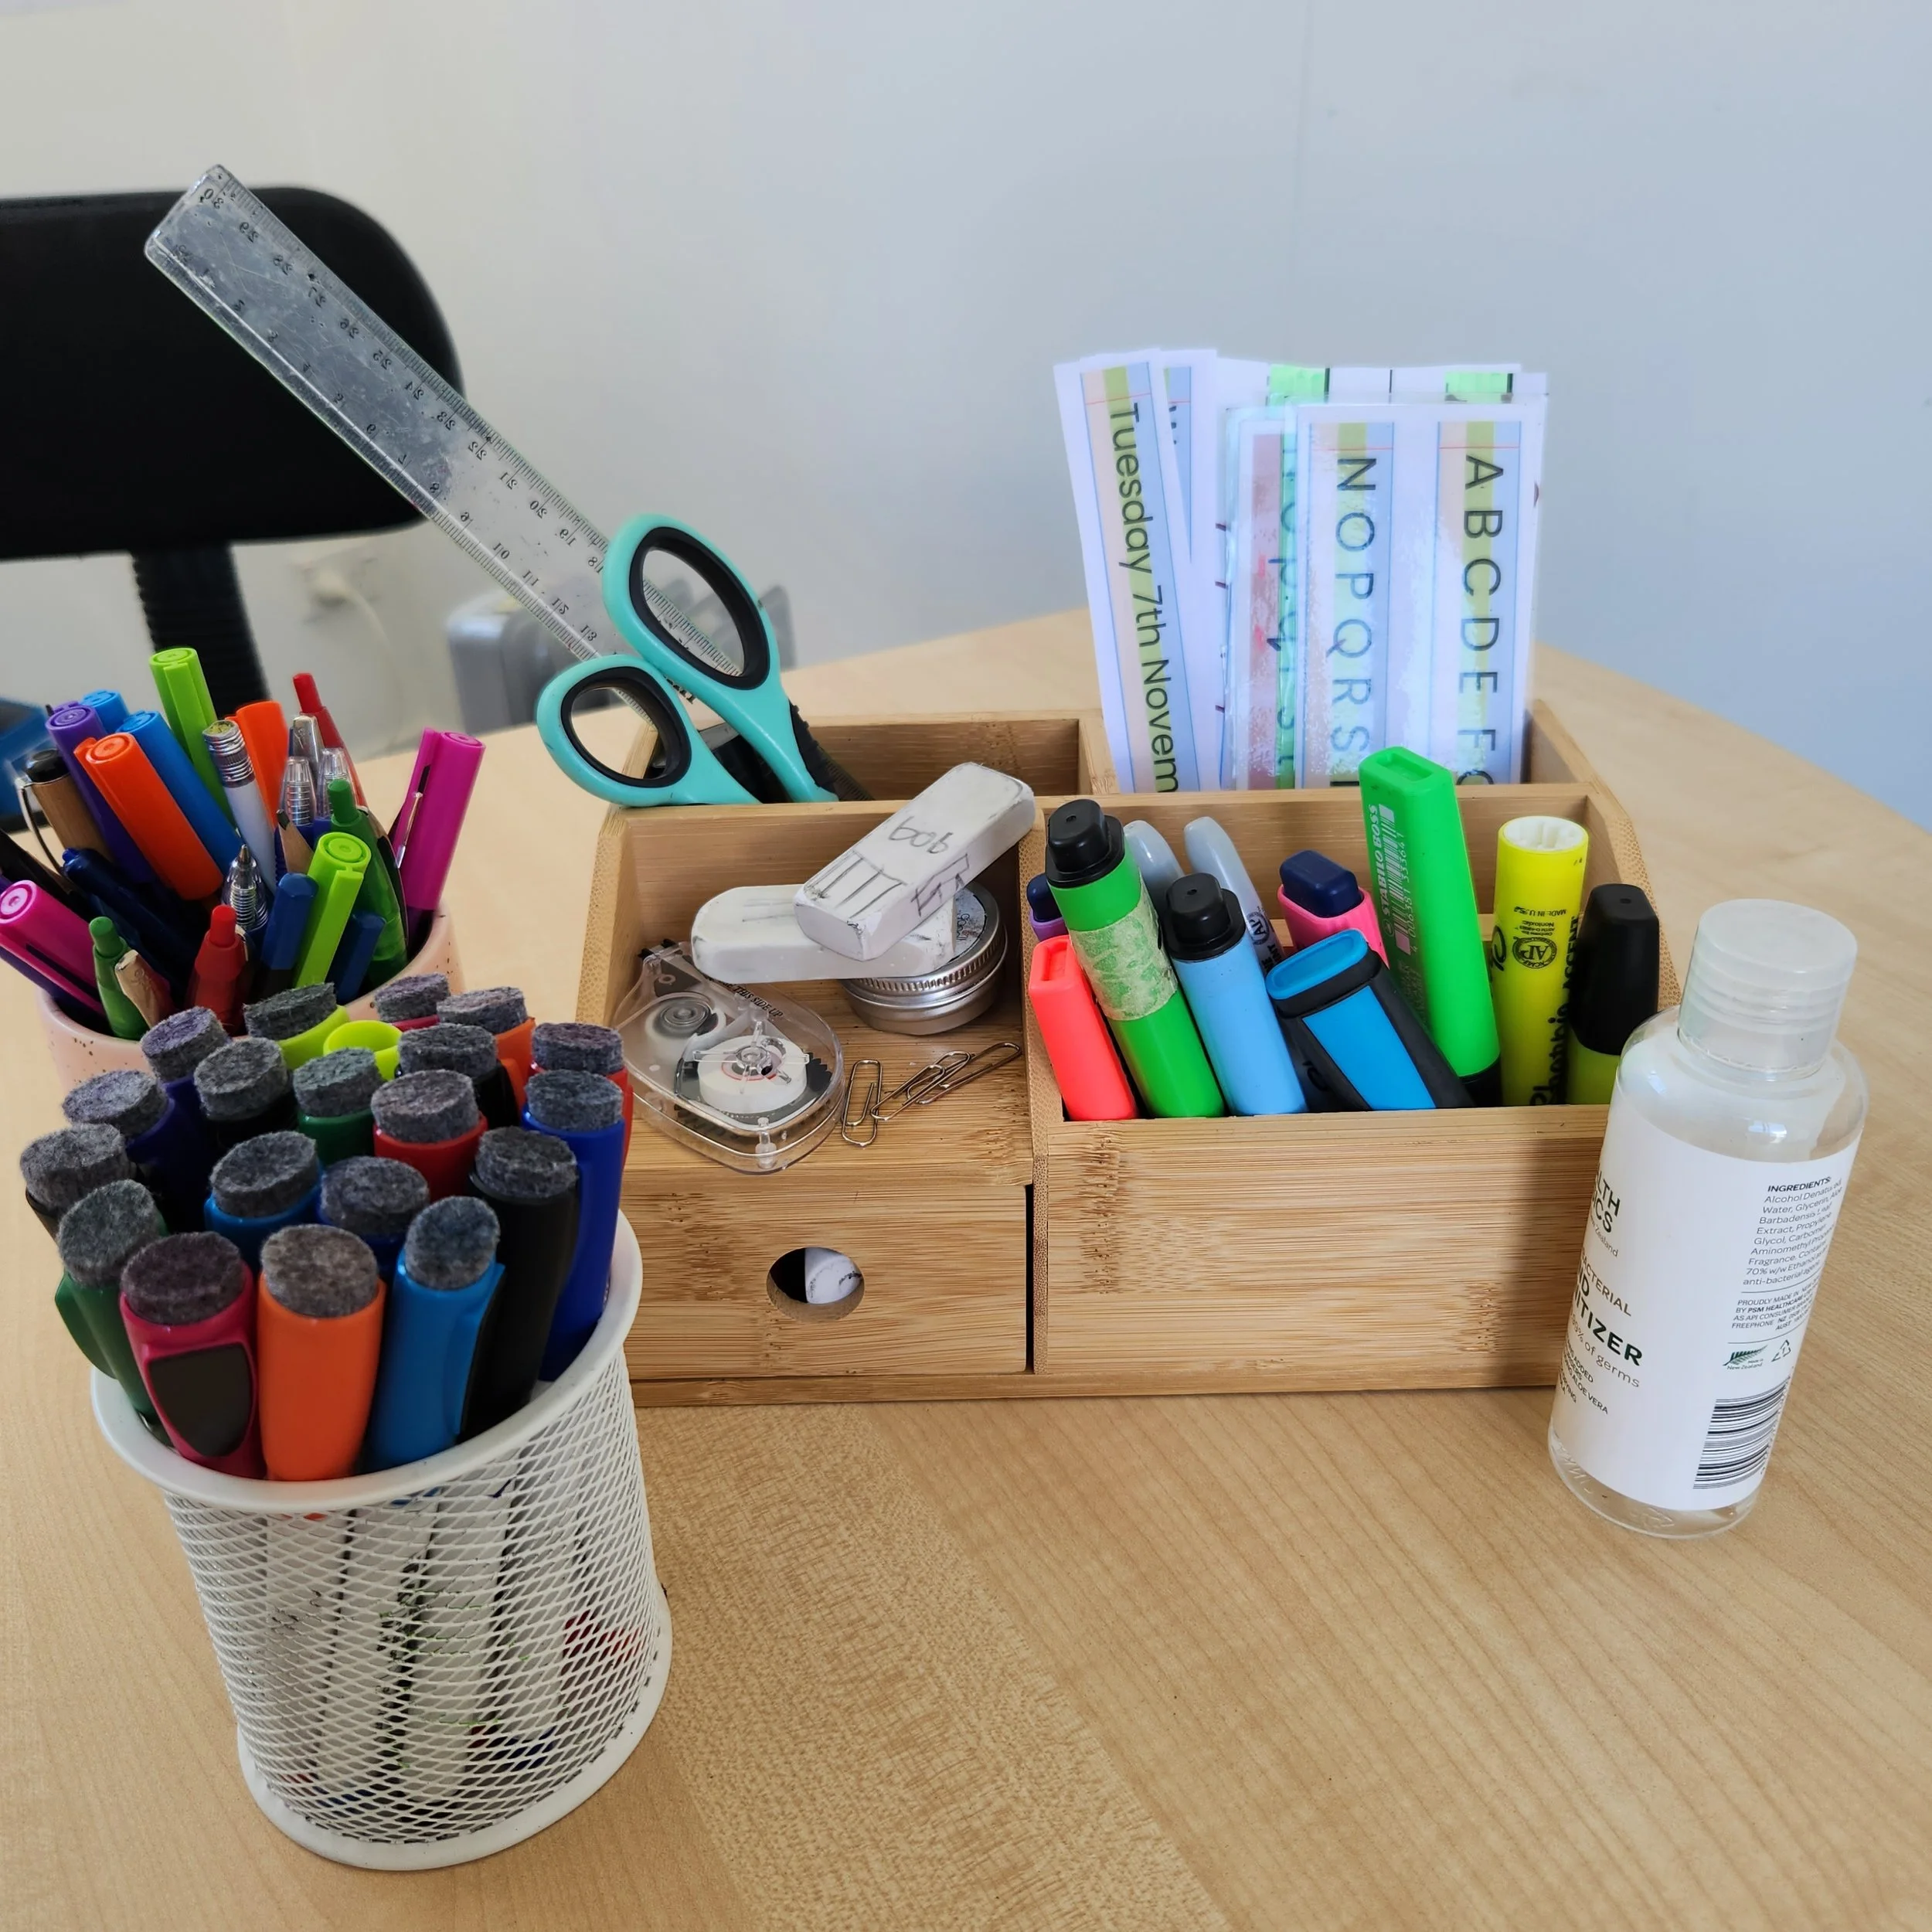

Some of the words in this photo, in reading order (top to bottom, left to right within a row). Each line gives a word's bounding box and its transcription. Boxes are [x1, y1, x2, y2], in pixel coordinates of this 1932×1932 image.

[1337, 458, 1376, 491] N
[1465, 455, 1504, 490] A
[1110, 402, 1154, 574] Tuesday
[1335, 512, 1375, 551] O
[1464, 510, 1502, 539] B
[1335, 573, 1374, 599] P
[1463, 558, 1501, 596] C
[1133, 585, 1167, 647] 7th
[1325, 618, 1372, 658] Q
[1461, 617, 1499, 651] D
[1332, 678, 1372, 705] R
[1459, 672, 1498, 693] E
[1141, 659, 1179, 793] Novem
[1330, 726, 1370, 753] S
[1458, 730, 1496, 751] F
[1369, 804, 1382, 849] BOSS
[1375, 850, 1390, 916] STABILO
[1520, 945, 1549, 960] AP
[733, 985, 754, 999] THIS
[751, 997, 771, 1011] SIDE
[769, 1008, 784, 1017] UP
[1596, 1165, 1621, 1217] LTH
[1764, 1193, 1803, 1203] Alcohol
[1593, 1190, 1613, 1233] ICS
[1760, 1213, 1816, 1224] Barbadensis
[1753, 1236, 1787, 1246] Glycol,
[1757, 1226, 1794, 1234] Extract,
[1748, 1255, 1797, 1266] Fragrance.
[1750, 1240, 1811, 1255] Aminomethyl
[1743, 1269, 1803, 1285] anti-bacterial
[1769, 1267, 1787, 1275] w/w
[1737, 1298, 1772, 1306] PROUDLY
[1575, 1286, 1642, 1366] ITIZER
[1731, 1319, 1774, 1328] FREEPHONE
[1573, 1355, 1594, 1383] ADDED
[1585, 1342, 1596, 1355] of
[1596, 1355, 1639, 1387] germs
[1572, 1375, 1587, 1396] ALOE
[1588, 1392, 1608, 1414] VERA
